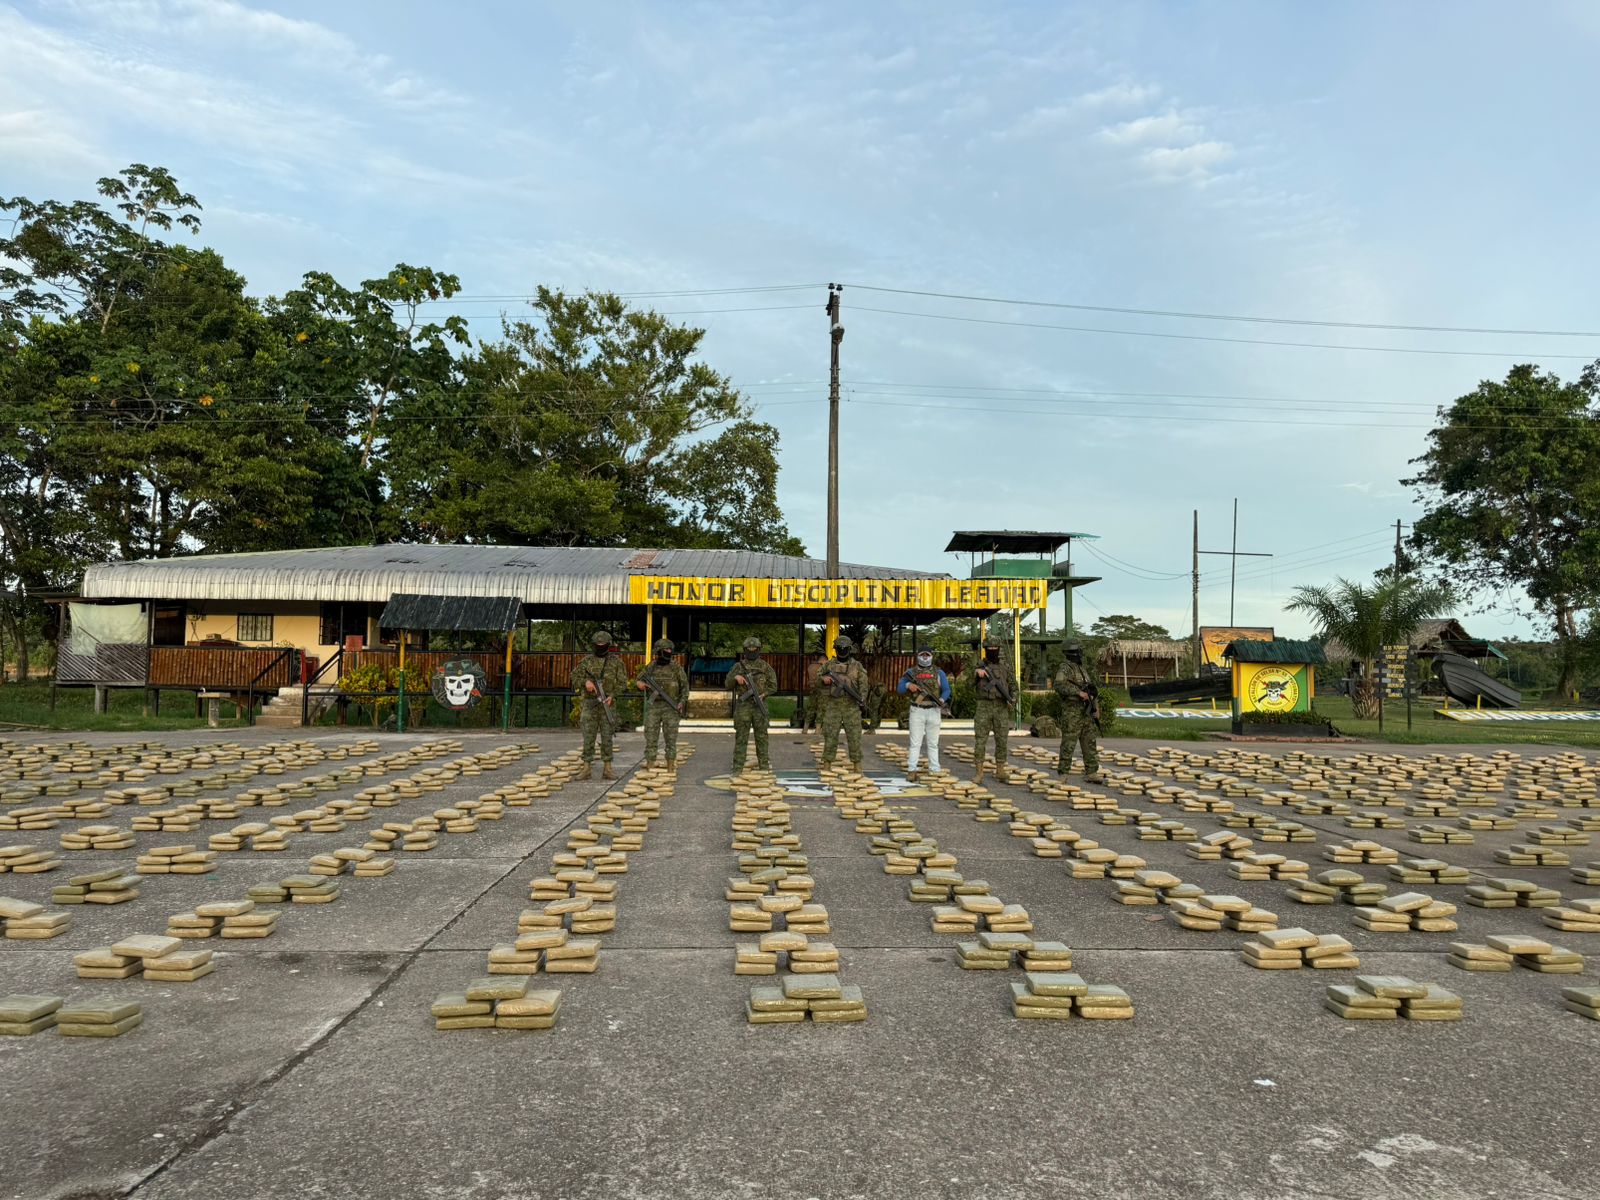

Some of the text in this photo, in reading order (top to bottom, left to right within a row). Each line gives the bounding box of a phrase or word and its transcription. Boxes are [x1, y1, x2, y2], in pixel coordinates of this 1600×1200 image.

[648, 581, 1042, 604] HONOR DISCIPLINA LEALTAD
